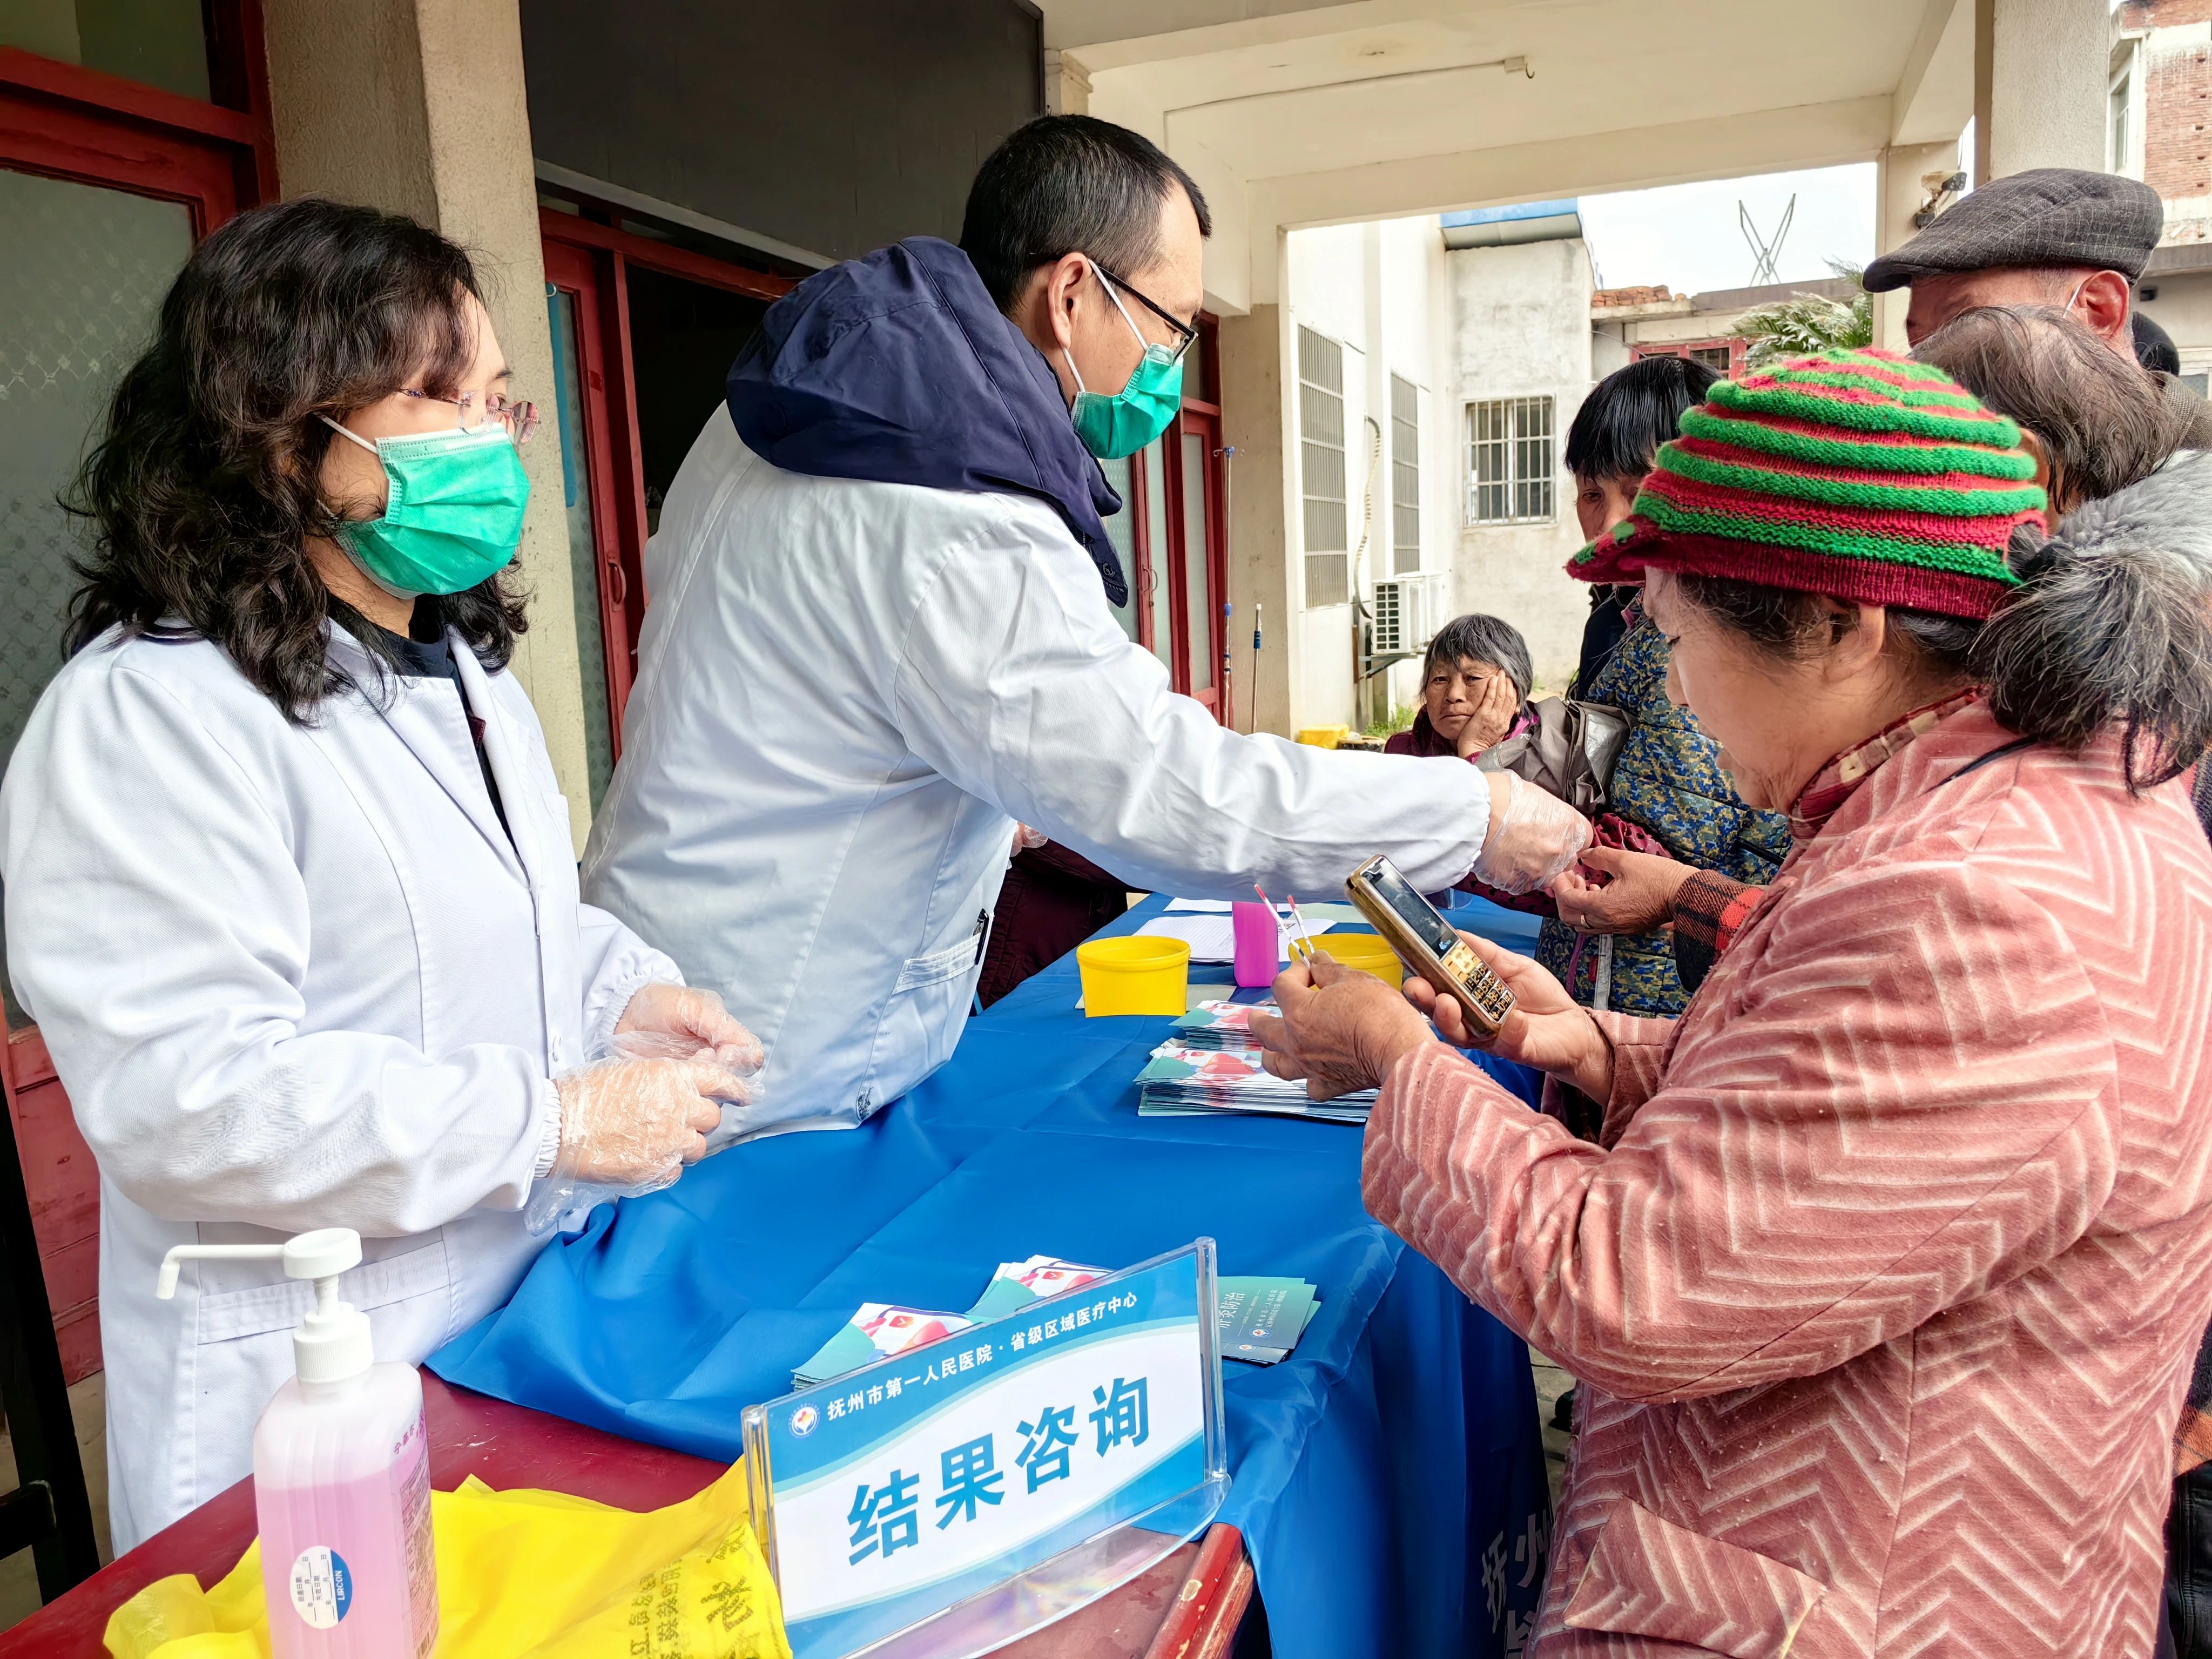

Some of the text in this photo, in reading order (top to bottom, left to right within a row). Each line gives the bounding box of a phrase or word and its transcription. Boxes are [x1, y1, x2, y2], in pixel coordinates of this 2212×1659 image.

[846, 1376, 1150, 1567] 结果咨询
[335, 1570, 345, 1601] LIRCON
